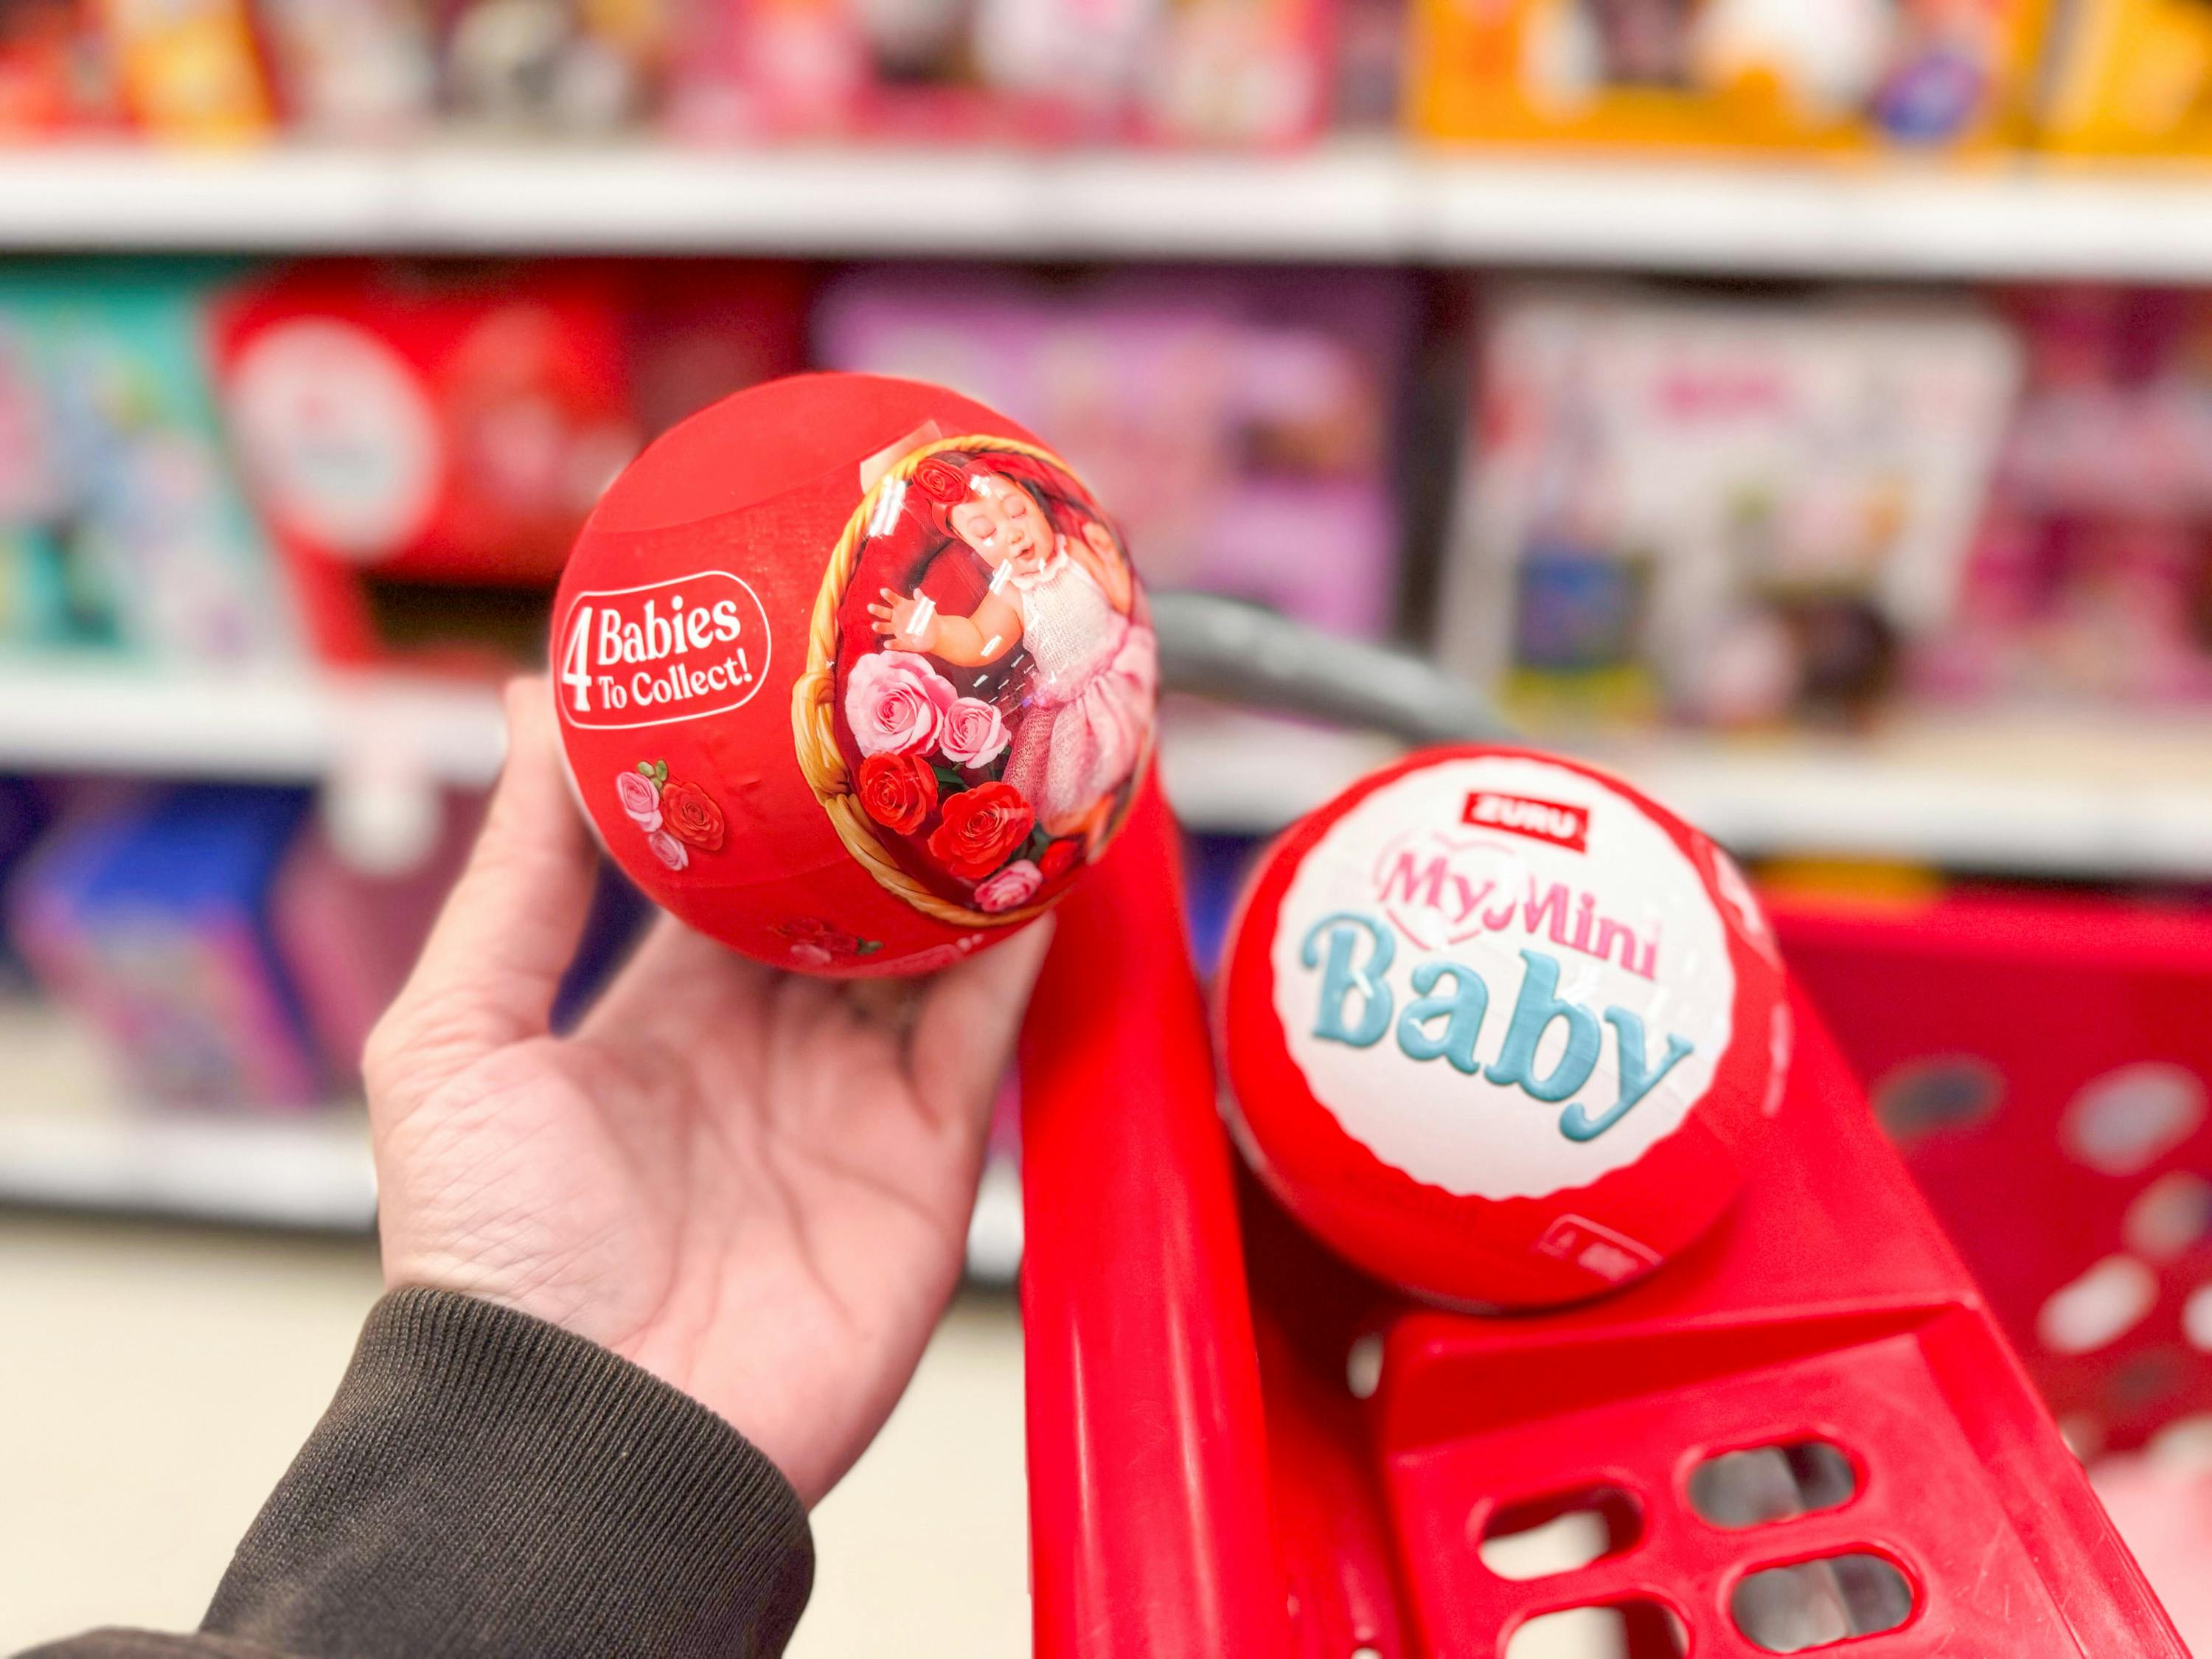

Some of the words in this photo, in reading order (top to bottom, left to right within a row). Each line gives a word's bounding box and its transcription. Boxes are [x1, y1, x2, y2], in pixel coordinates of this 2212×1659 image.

[562, 606, 593, 712] 4
[597, 594, 742, 666] Babies
[597, 675, 627, 709] To
[631, 647, 754, 706] Collect!
[1472, 796, 1577, 839] ZURU
[1380, 852, 1496, 926] My
[1481, 871, 1660, 981] Mini
[1301, 912, 1695, 1143] Baby
